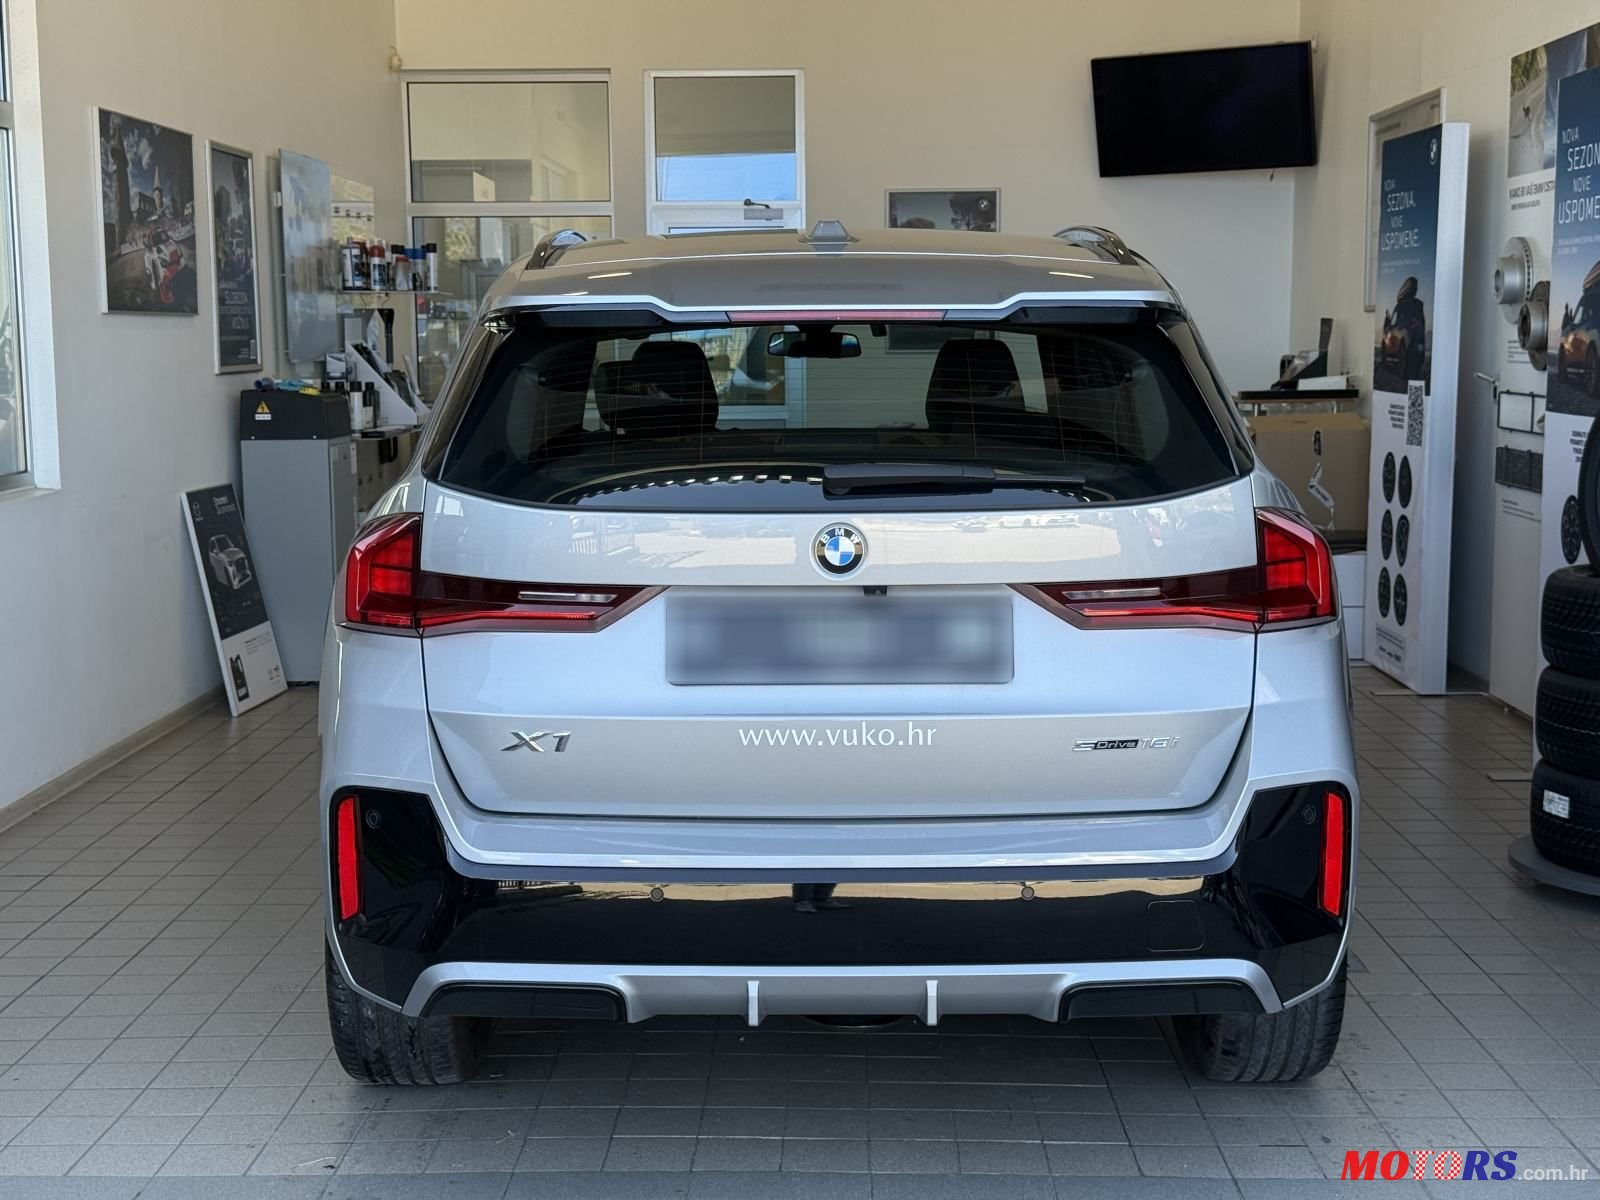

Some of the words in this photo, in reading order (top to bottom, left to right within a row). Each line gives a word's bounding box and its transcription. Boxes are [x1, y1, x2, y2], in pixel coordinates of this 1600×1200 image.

[1562, 127, 1579, 144] NOVA
[1573, 175, 1591, 192] NOVE
[820, 528, 861, 544] BMW
[500, 731, 571, 752] X1
[738, 720, 937, 746] www.vuko.hr
